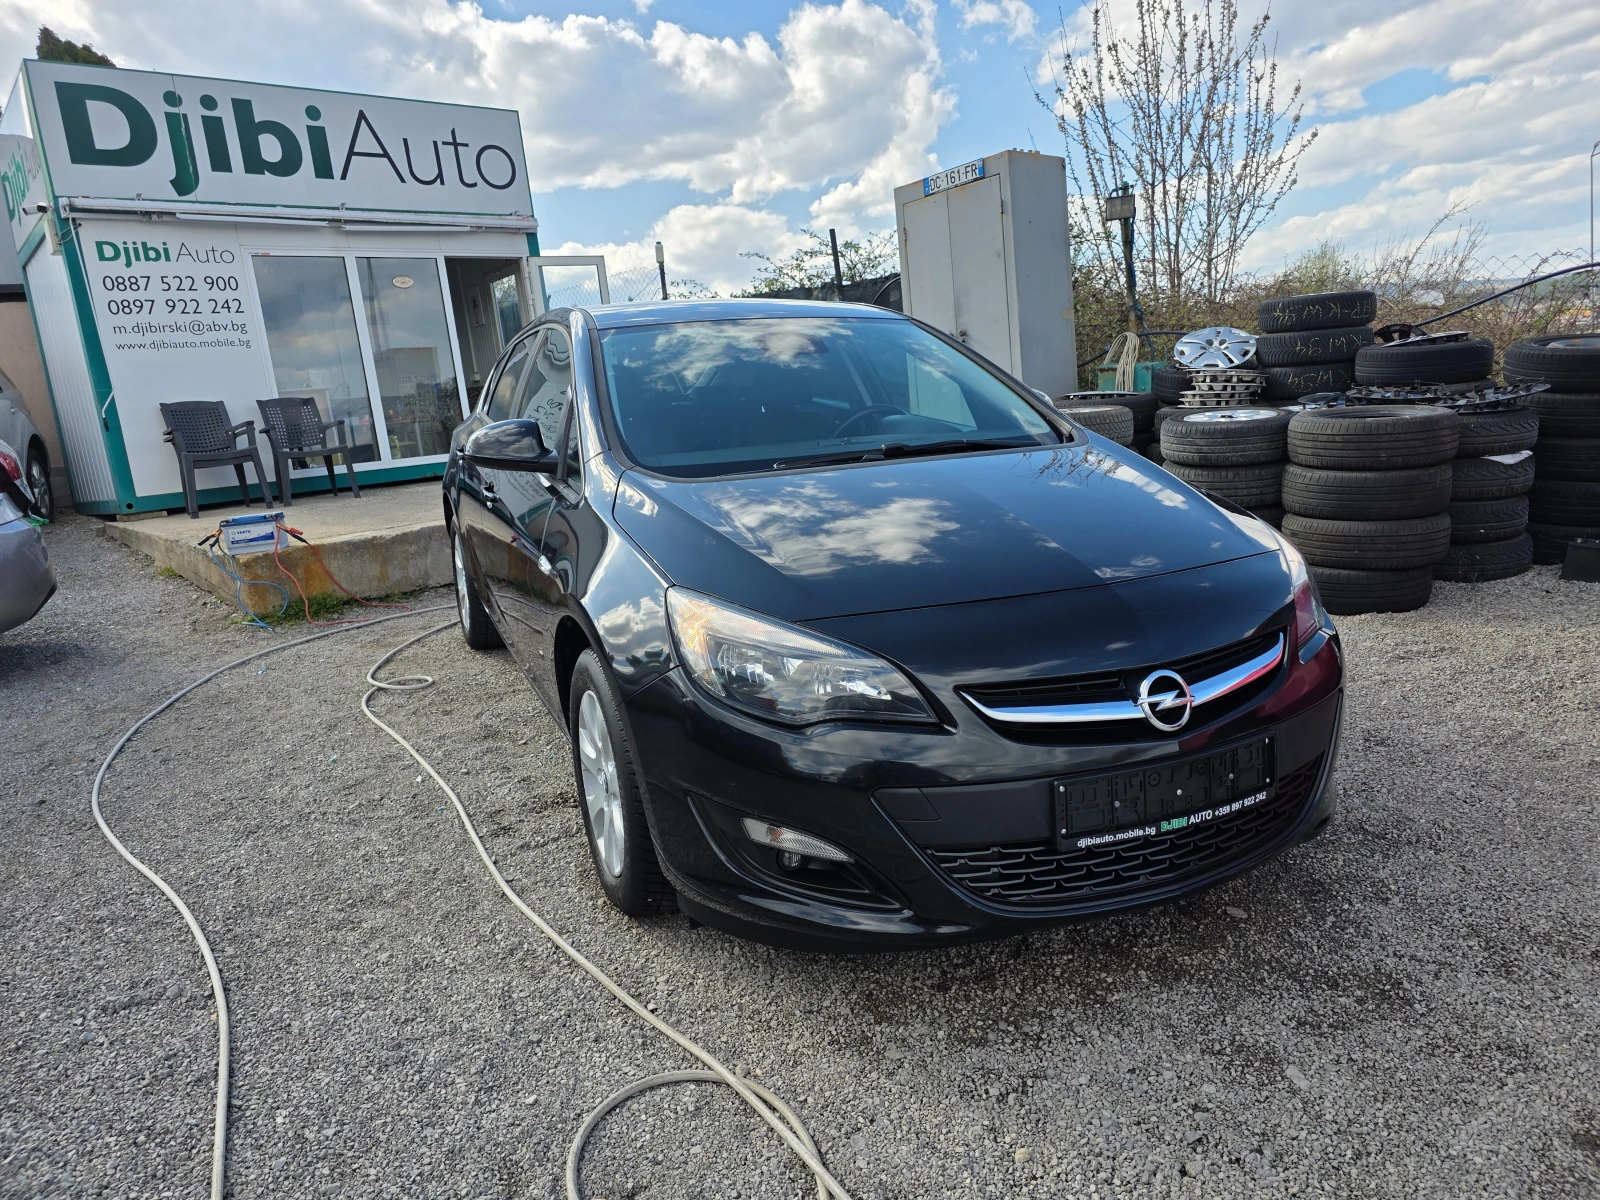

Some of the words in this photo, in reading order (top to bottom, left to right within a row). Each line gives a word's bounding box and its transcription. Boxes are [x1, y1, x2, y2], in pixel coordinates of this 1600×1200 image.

[95, 240, 171, 268] Djibi
[175, 242, 235, 264] Auto
[102, 275, 151, 292] 0887
[160, 275, 198, 292] 522
[203, 275, 239, 292] 900
[107, 299, 155, 315] 0897
[165, 298, 202, 315] 922
[208, 298, 245, 314] 242
[113, 320, 248, 337] m.djibirski@abv.bg
[115, 338, 251, 351] www.djibiauto.mobile.bg
[1077, 826, 1156, 848] djibiauto.mobile.bg
[1160, 816, 1188, 832] DJIBI
[1188, 809, 1213, 825] AUTO
[1214, 803, 1230, 817] +359
[1231, 800, 1243, 811] 897
[1243, 796, 1255, 807] 922
[1255, 791, 1267, 803] 242
